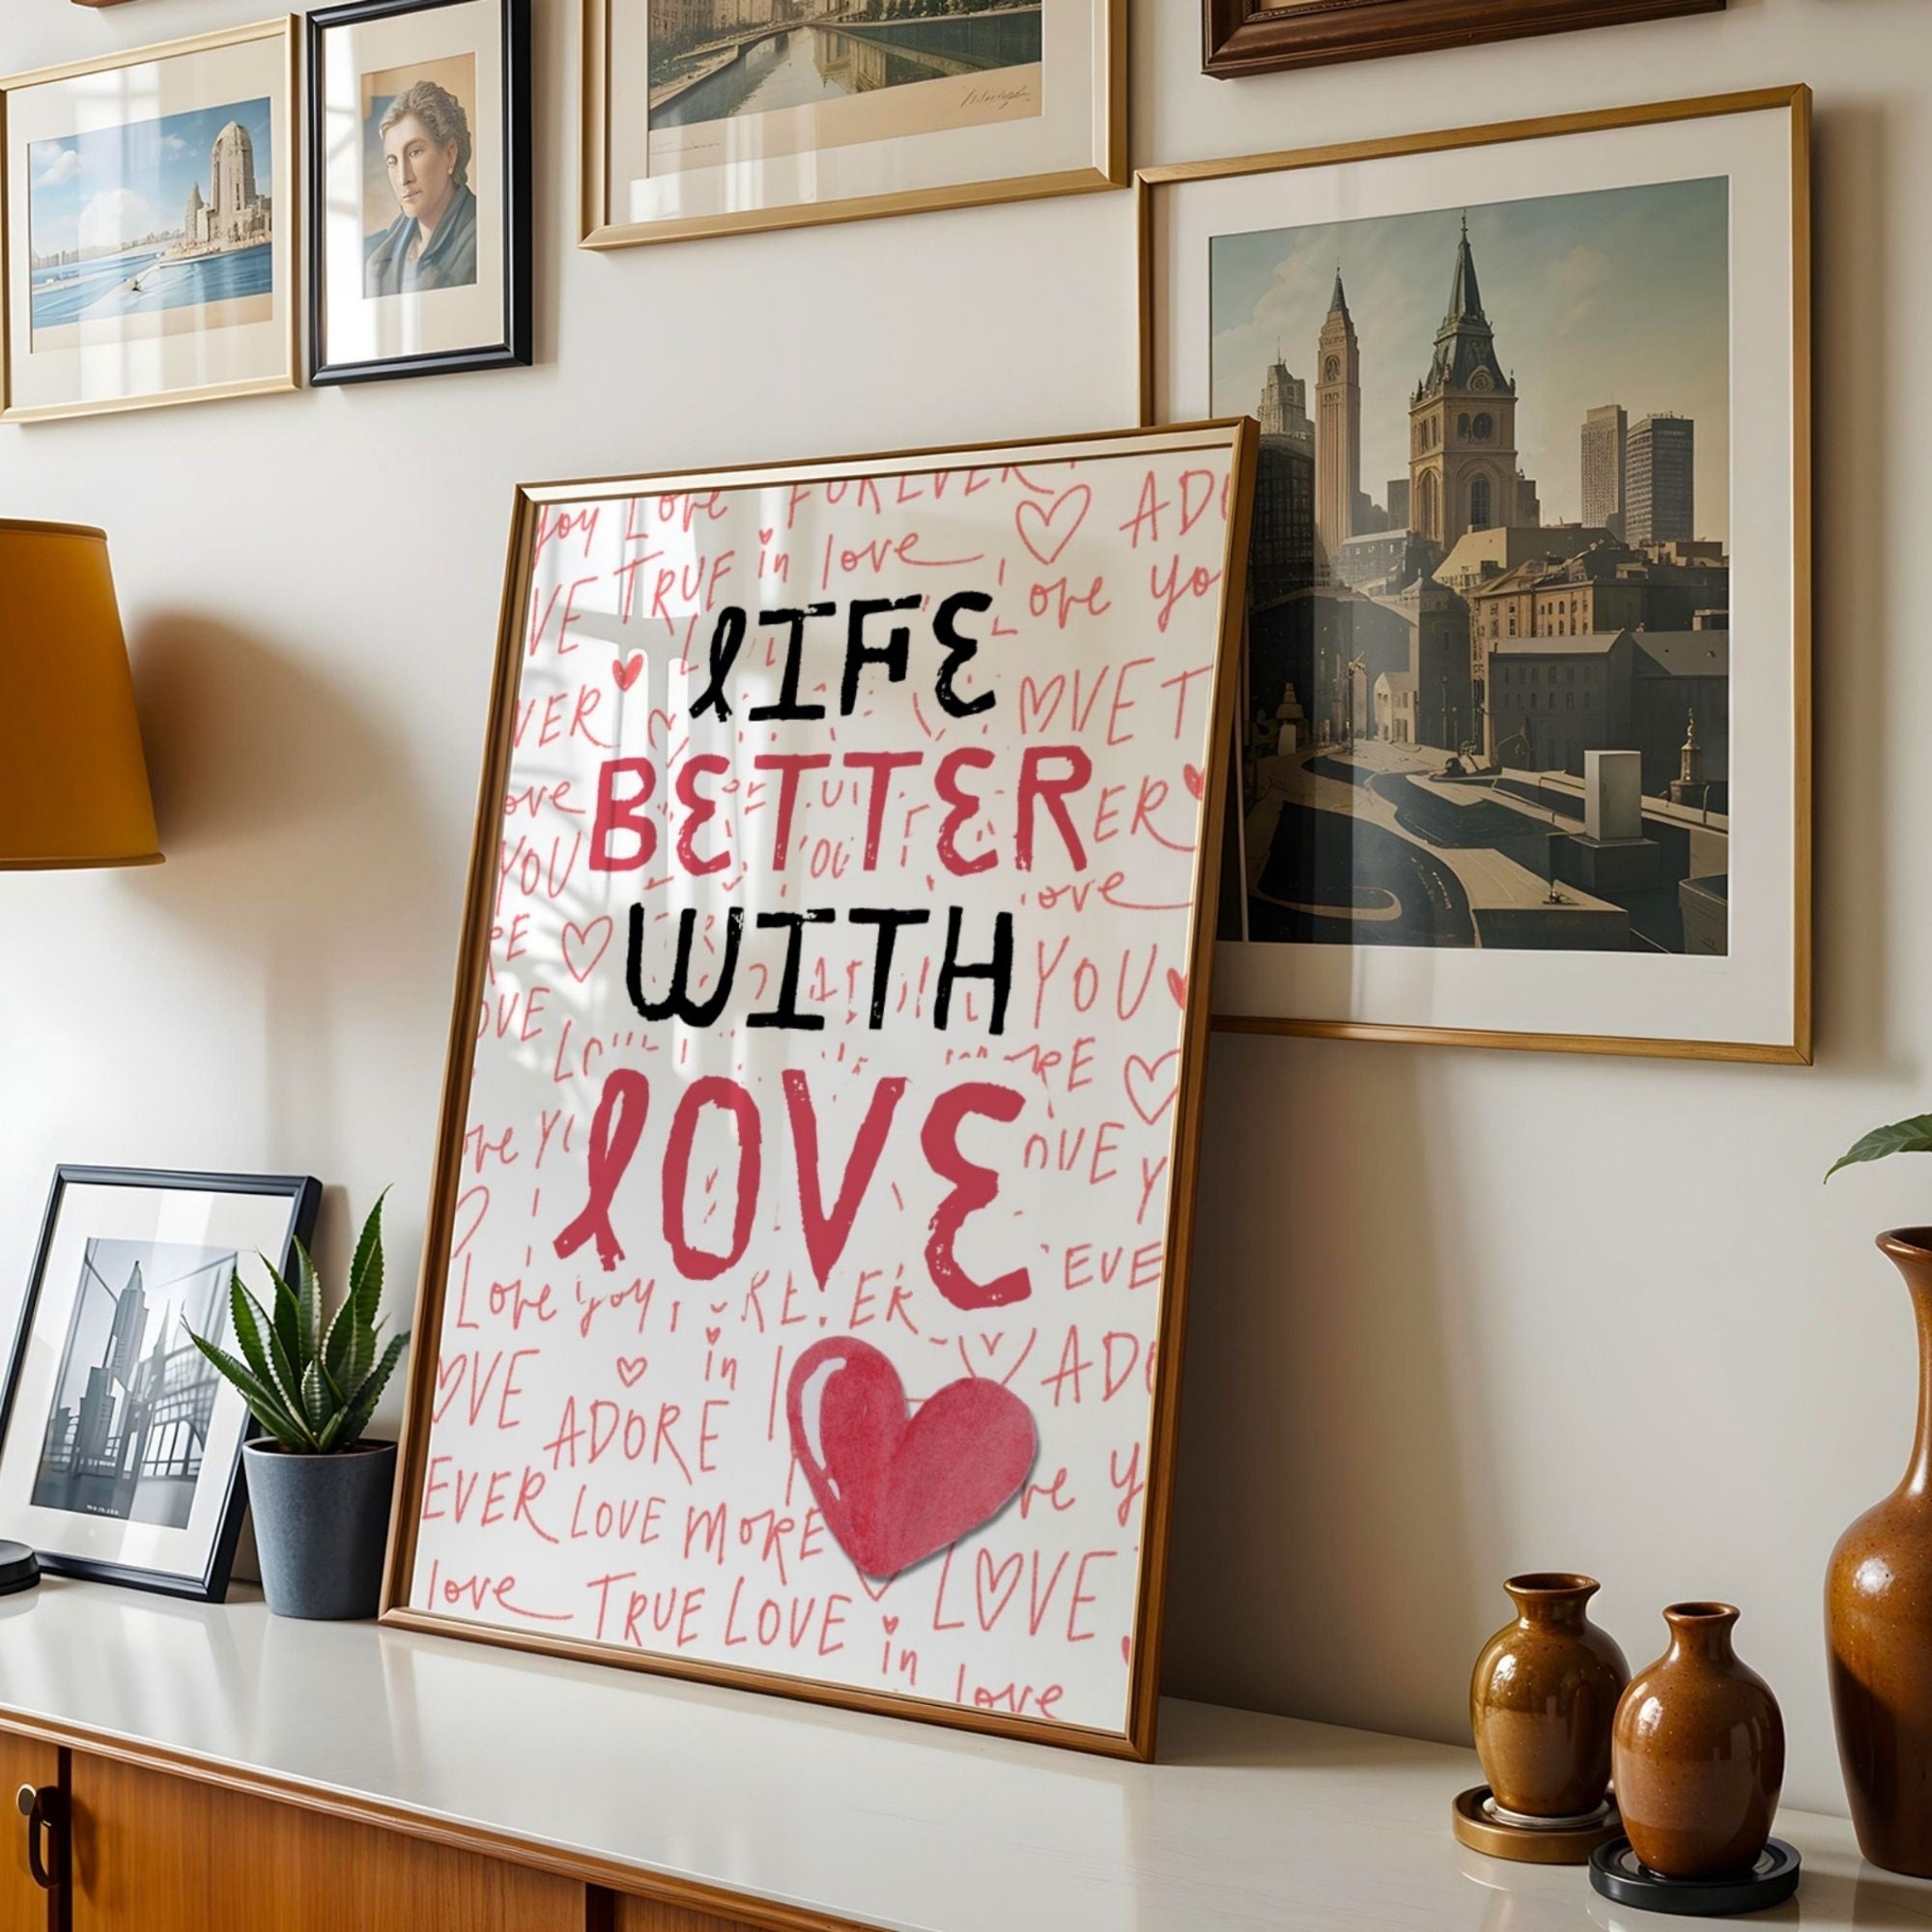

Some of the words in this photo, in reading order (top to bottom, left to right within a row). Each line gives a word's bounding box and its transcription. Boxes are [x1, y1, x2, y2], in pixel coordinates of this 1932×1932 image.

[822, 533, 984, 592] love
[589, 745, 1093, 877] BETTER
[626, 902, 1014, 1036] WITH
[1034, 935, 1157, 1030] YOU
[543, 1395, 729, 1486] ADORE
[422, 1456, 559, 1545] EVER
[571, 1484, 667, 1545] LOVE
[428, 1559, 574, 1621] love
[586, 1571, 706, 1648] TRUE
[724, 1575, 852, 1656] LOVE
